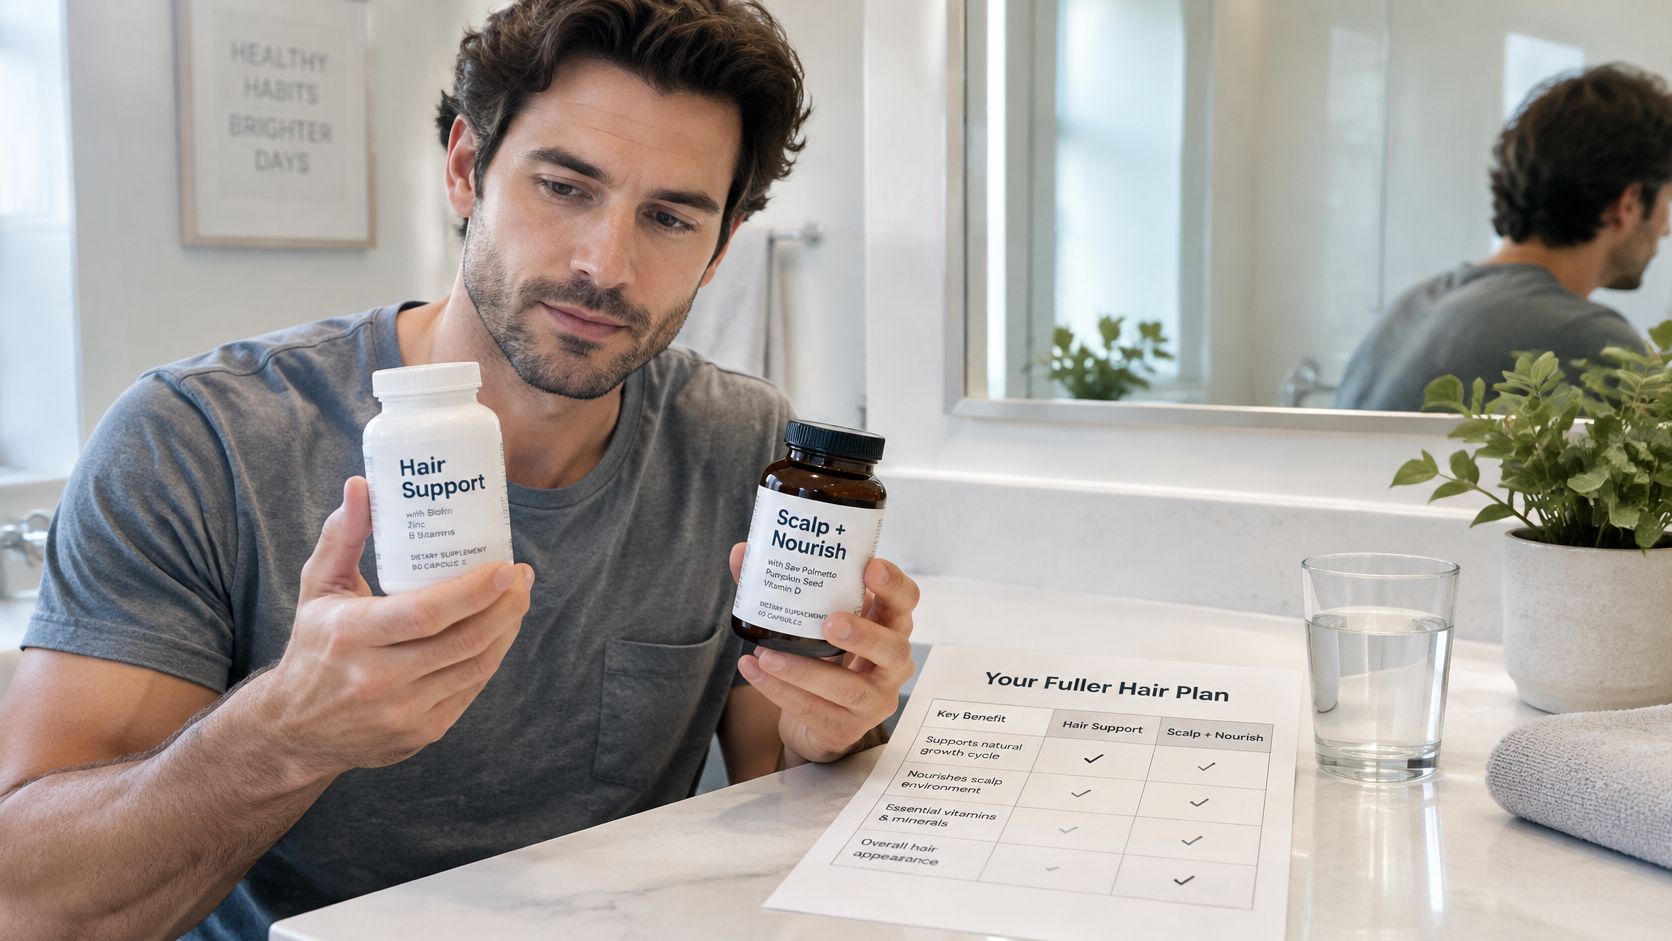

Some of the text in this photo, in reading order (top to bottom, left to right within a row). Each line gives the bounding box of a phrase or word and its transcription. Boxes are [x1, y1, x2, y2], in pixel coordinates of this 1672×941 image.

[230, 40, 329, 73] HEALTHY
[243, 76, 319, 106] HABITS
[229, 113, 333, 143] BRIGHTER
[254, 149, 310, 174] DAYS
[400, 456, 446, 476] Hair
[402, 474, 486, 501] Support
[777, 509, 846, 537] Scalp +
[772, 529, 847, 560] Nourish
[768, 559, 784, 568] with
[794, 587, 802, 595] D
[803, 578, 824, 588] Seed
[985, 671, 1230, 702] Your Fuller Hair Plan
[936, 710, 1007, 723] Key Benefit
[1062, 720, 1144, 735] Hair Support
[1167, 728, 1201, 738] Scalp
[1214, 731, 1264, 742] Nourish
[925, 736, 1023, 751] Supports natural
[920, 747, 1000, 760] growth cycle
[907, 770, 1003, 786] Nourishes scalp
[901, 782, 982, 795] environment
[885, 803, 997, 821] Essential vitamins
[878, 814, 949, 828] & minerals
[861, 838, 938, 853] Overall hair
[853, 850, 939, 866] appearance
